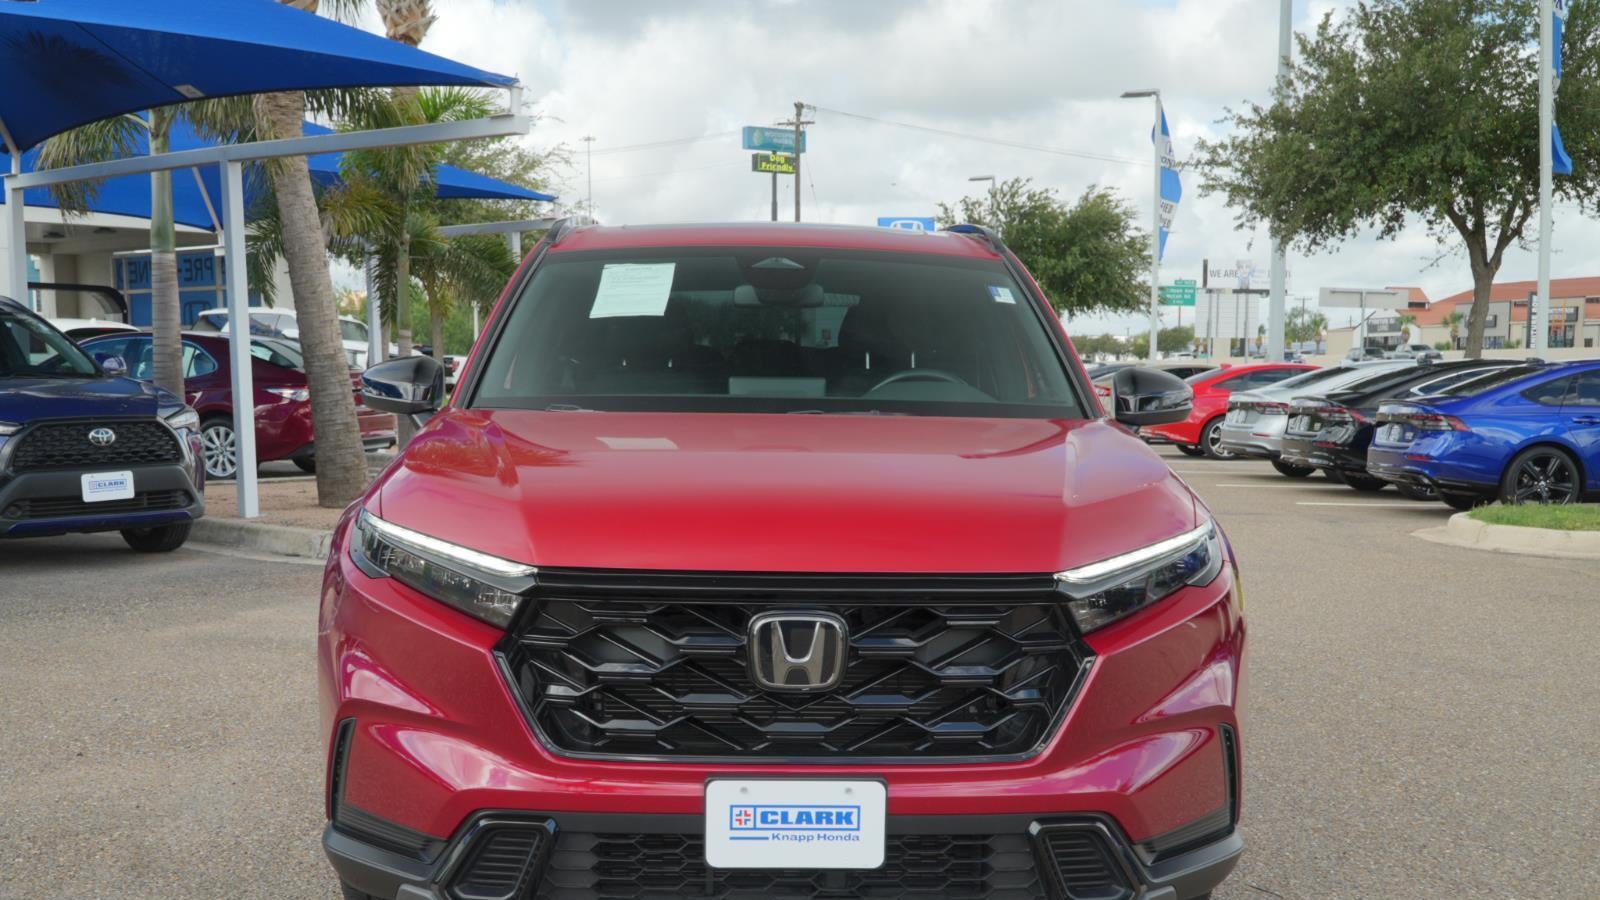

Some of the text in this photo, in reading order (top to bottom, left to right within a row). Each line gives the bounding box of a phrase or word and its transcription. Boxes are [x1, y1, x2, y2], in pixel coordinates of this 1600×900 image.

[770, 154, 785, 164] Dog
[1209, 269, 1222, 278] WE
[760, 810, 854, 826] CLARK
[771, 832, 860, 843] Knapp Honda
